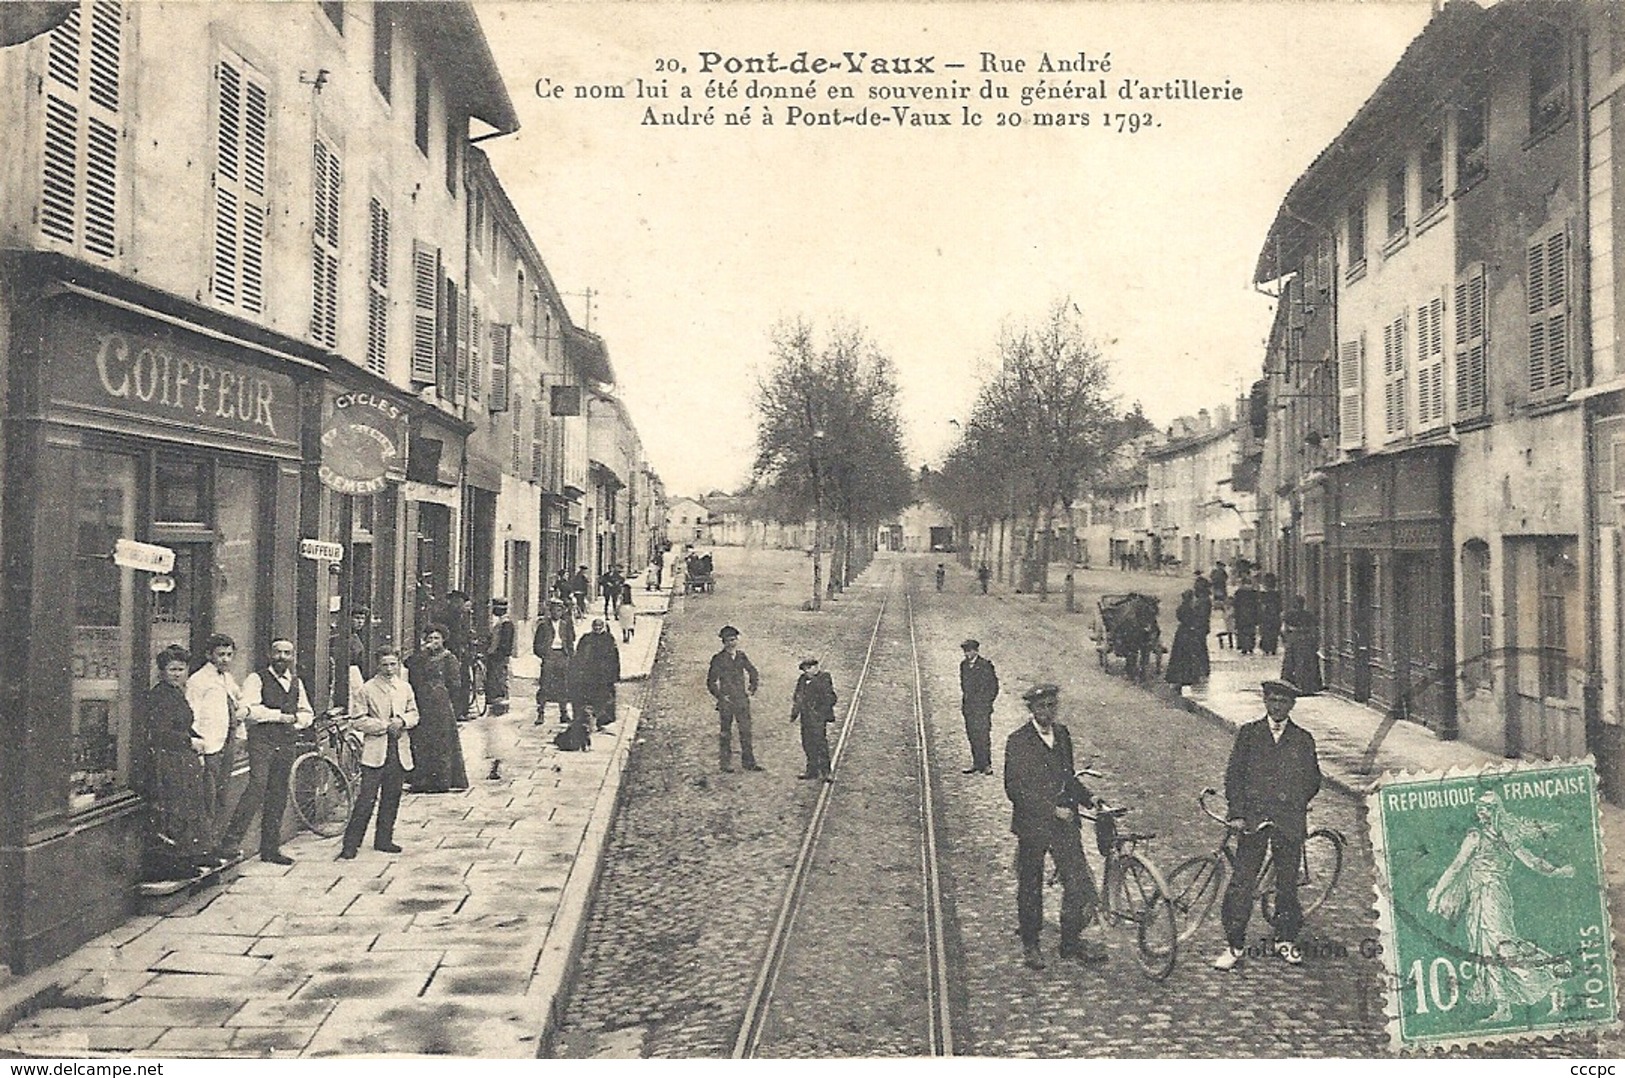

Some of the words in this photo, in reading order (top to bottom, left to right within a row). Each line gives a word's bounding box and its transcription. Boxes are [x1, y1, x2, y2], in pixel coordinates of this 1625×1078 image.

[96, 334, 277, 436] COIFFEUR
[336, 392, 400, 419] CYCLES
[301, 543, 341, 558] COIFFEUR
[1503, 775, 1587, 801] FRANÇAISE
[1579, 924, 1606, 1010] POSTES
